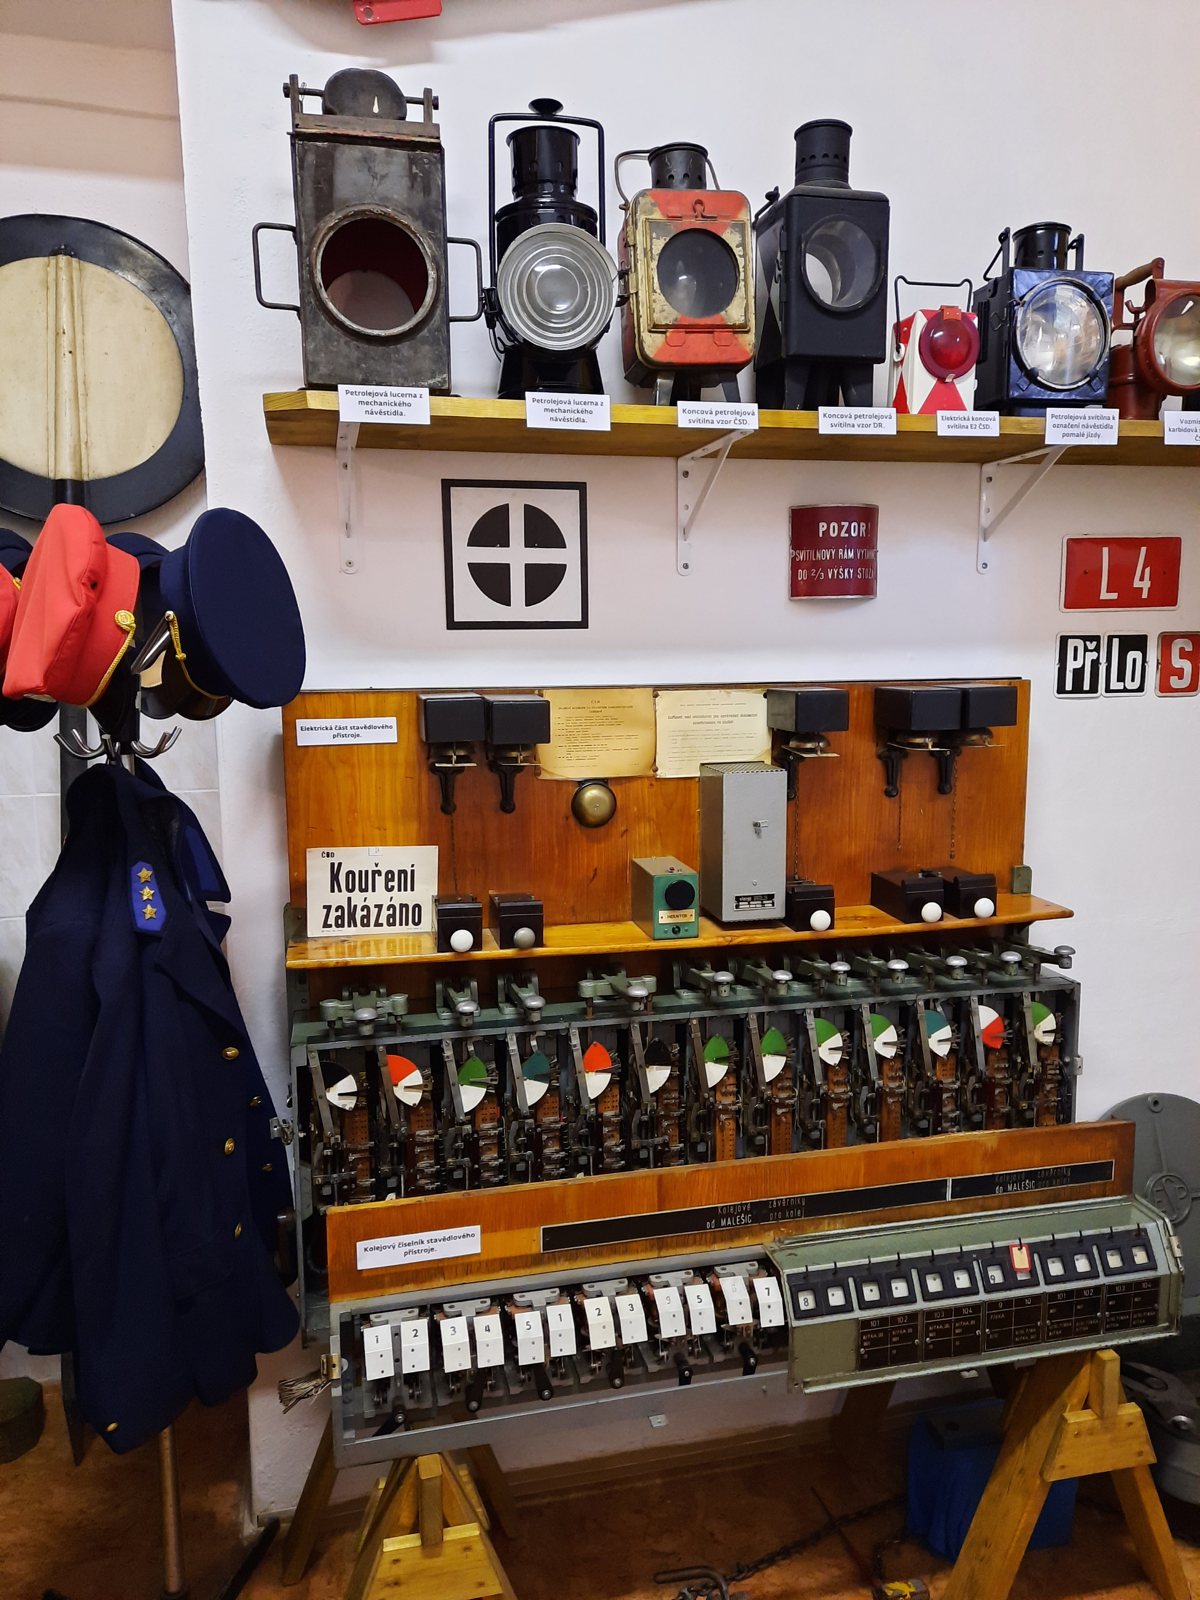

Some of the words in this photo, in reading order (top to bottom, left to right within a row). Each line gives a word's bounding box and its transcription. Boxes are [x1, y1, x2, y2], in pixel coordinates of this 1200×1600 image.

[345, 389, 388, 398] Petrolejová
[532, 397, 572, 406] Petrolejová
[543, 407, 594, 415] mechanického
[714, 409, 756, 417] petrolejová
[854, 413, 893, 421] petrolejová
[1051, 413, 1087, 421] Petrolejová
[1081, 422, 1114, 430] návěstidla
[818, 521, 871, 538] POZOR!
[838, 545, 855, 560] RÁM
[827, 566, 854, 580] VÝŠKY
[1100, 546, 1119, 600] L
[1133, 546, 1152, 599] 4
[1065, 638, 1099, 691] Př
[1109, 637, 1144, 690] Lo
[1169, 638, 1194, 689] S
[349, 723, 393, 731] stavědlového
[329, 861, 416, 894] Kouření
[321, 896, 423, 929] zakázáno
[1007, 1179, 1036, 1192] MALEŠIC
[717, 1202, 751, 1215] Kolejové
[706, 1219, 716, 1229] od
[720, 1213, 752, 1227] MALEŠIC
[769, 1211, 782, 1221] pro
[785, 1208, 805, 1219] kolej
[363, 1242, 396, 1253] Kolejový
[426, 1232, 476, 1244] stavědlového
[764, 1287, 770, 1296] 7
[1057, 1292, 1067, 1300] 101
[1083, 1288, 1094, 1296] 102
[696, 1294, 703, 1304] 5
[803, 1296, 810, 1307] 8
[595, 1307, 603, 1317] 2
[628, 1303, 635, 1312] 3
[557, 1313, 563, 1322] 1
[897, 1315, 909, 1323] 102
[484, 1324, 491, 1333] 4
[525, 1320, 532, 1330] 5
[870, 1320, 880, 1328] 101
[411, 1328, 419, 1338] 2
[449, 1326, 457, 1336] 3
[374, 1335, 380, 1344] 1
